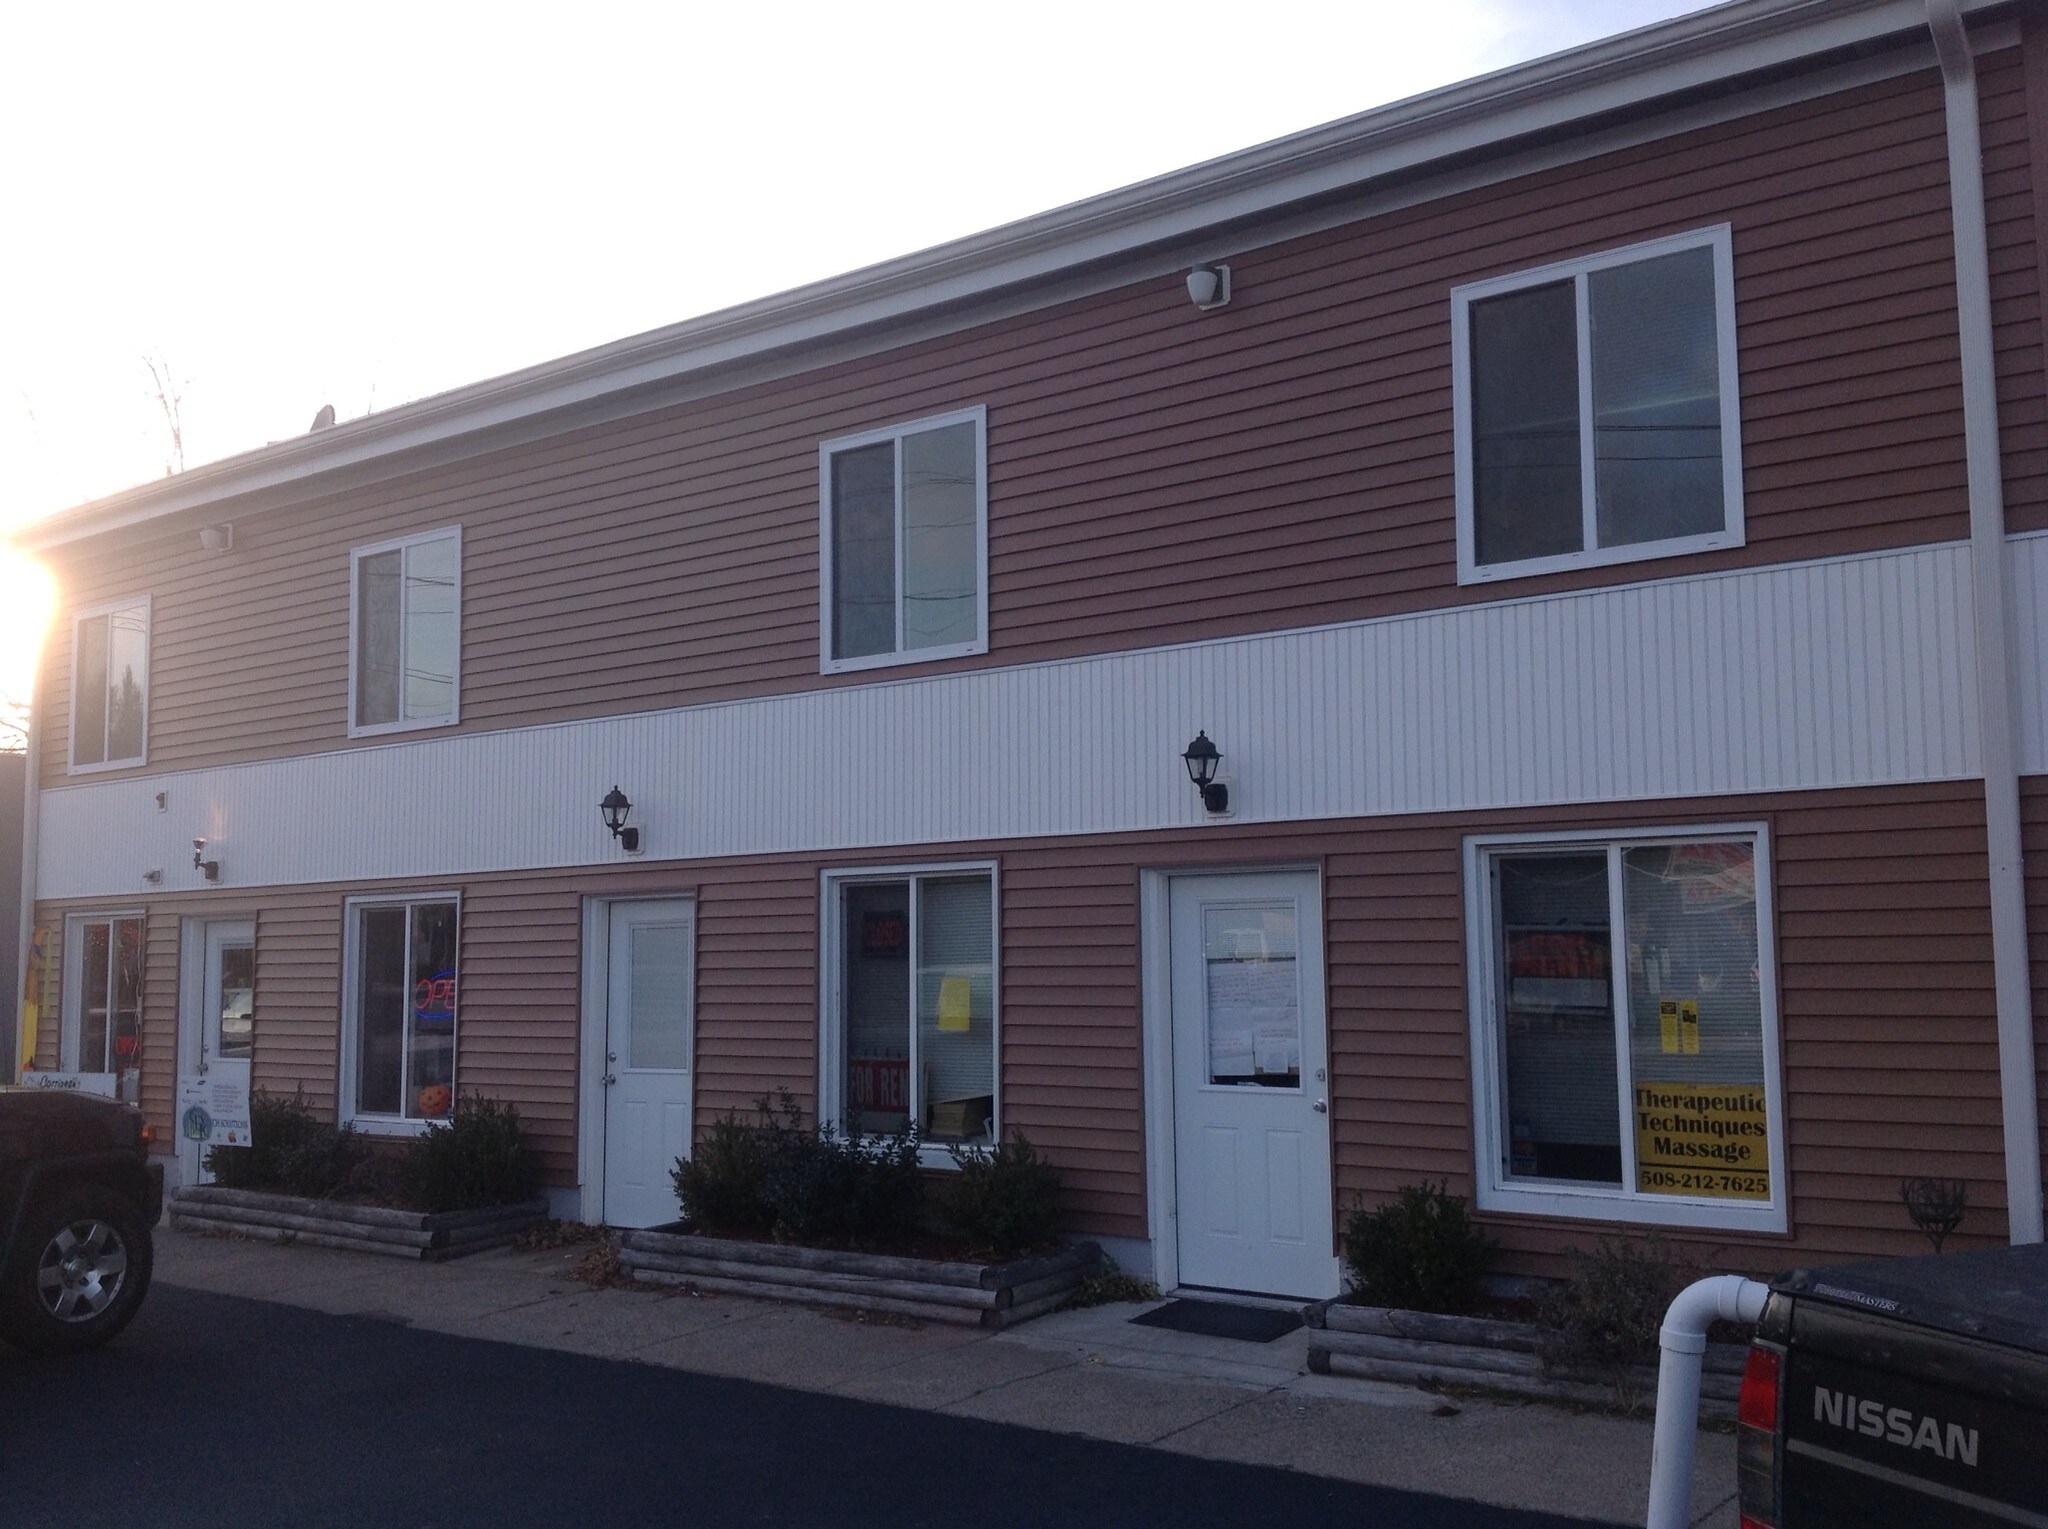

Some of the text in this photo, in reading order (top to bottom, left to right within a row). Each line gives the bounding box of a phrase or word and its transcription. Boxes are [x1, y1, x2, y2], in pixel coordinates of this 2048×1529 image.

[415, 979, 456, 1009] OPE
[880, 1067, 909, 1106] REN
[1635, 1089, 1766, 1114] Therapeutic
[1638, 1112, 1766, 1139] Techniques
[1654, 1137, 1751, 1163] Massage
[1641, 1171, 1767, 1193] 508-212-7625
[1855, 1293, 1899, 1311] MASTERS
[1813, 1386, 1979, 1467] NISSAN
